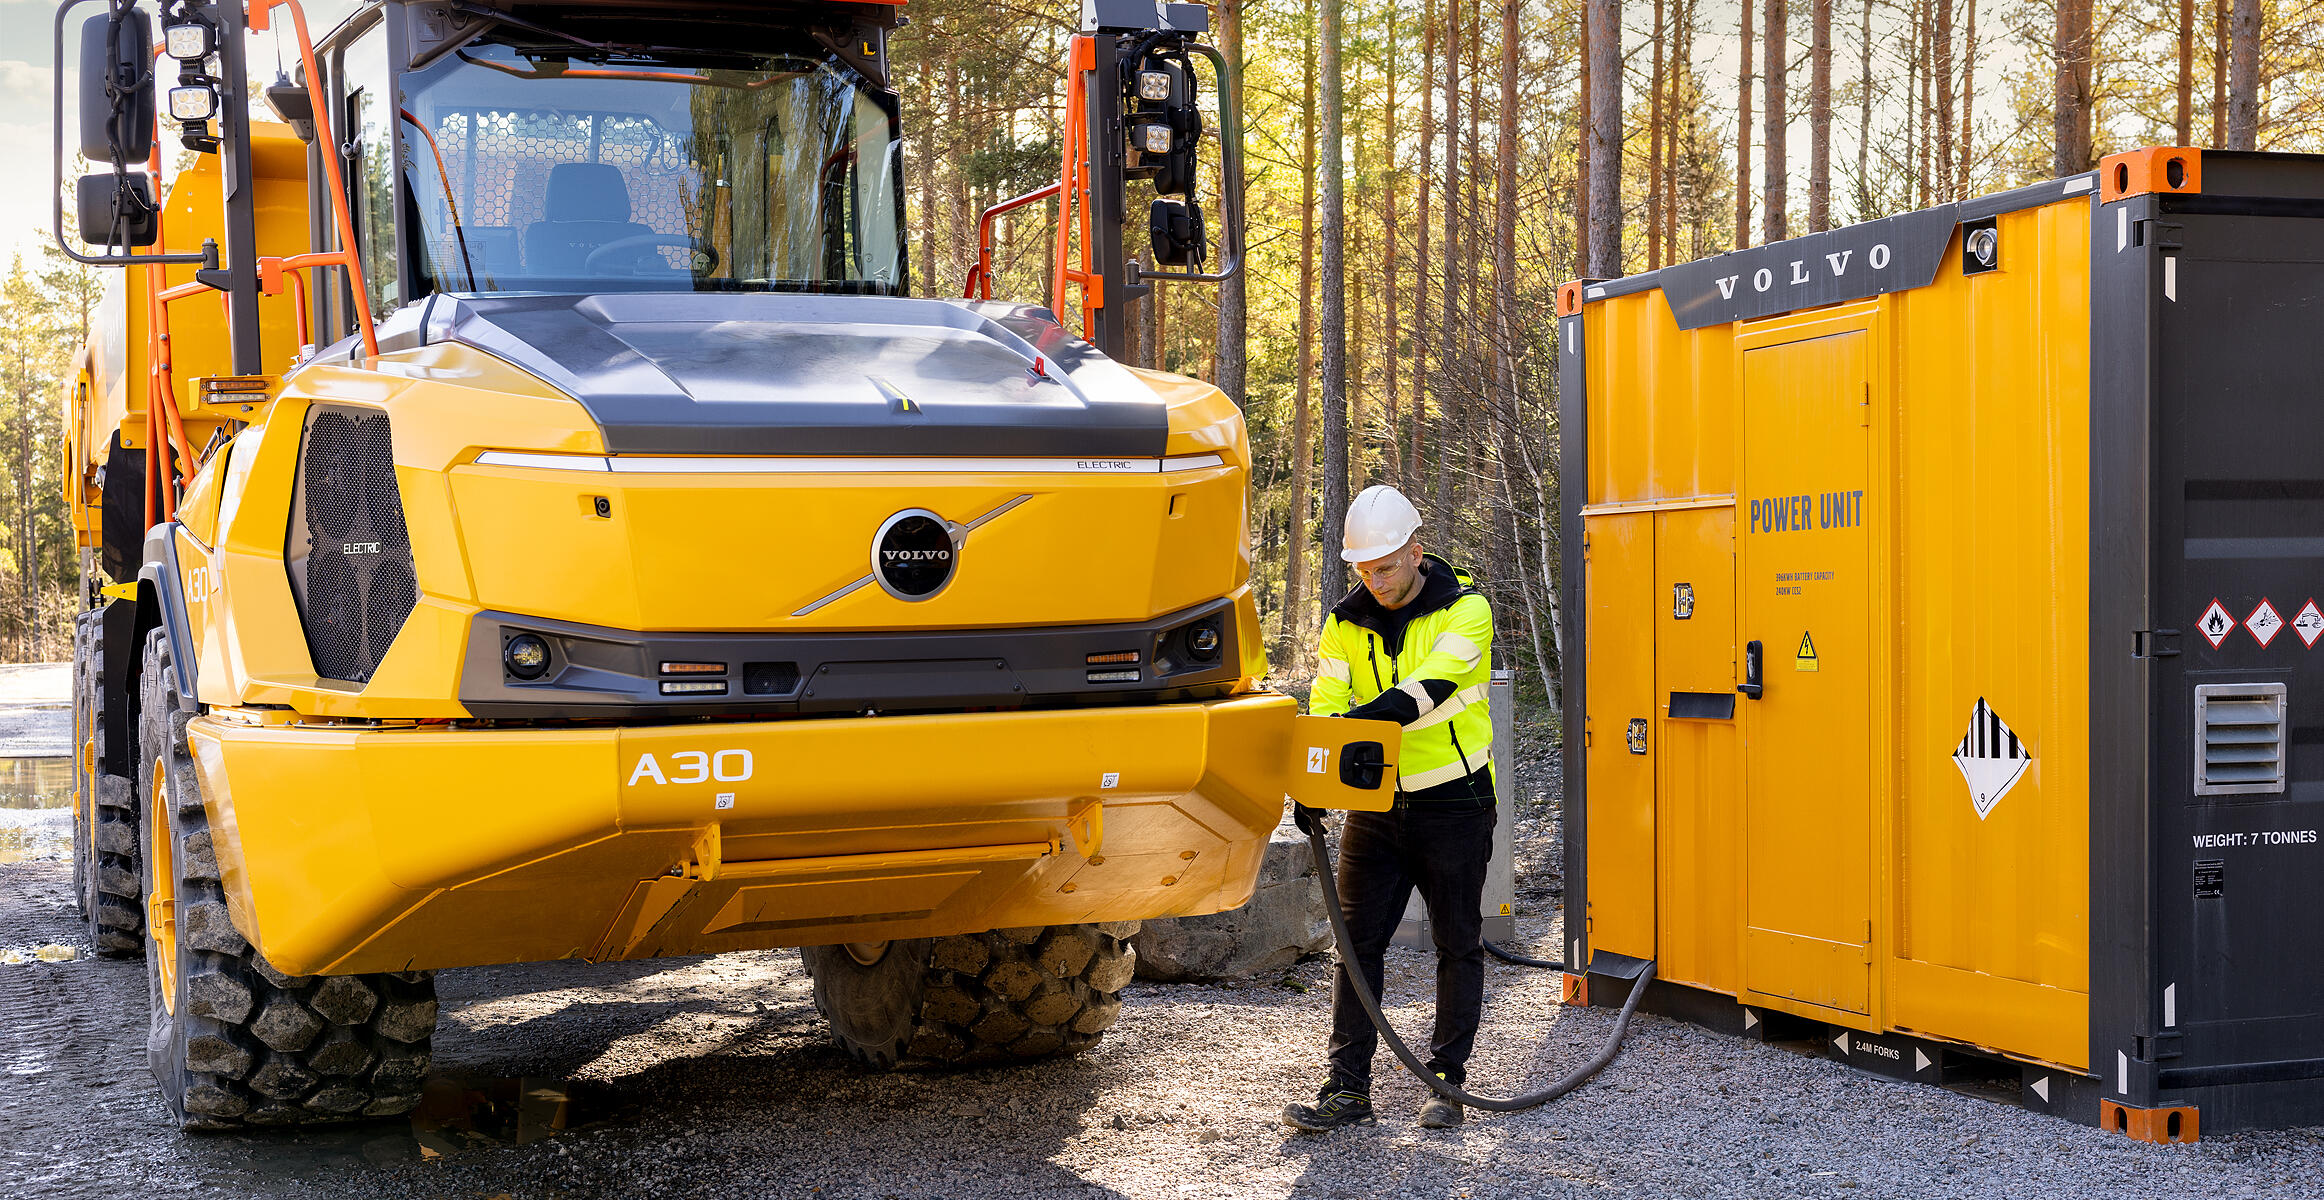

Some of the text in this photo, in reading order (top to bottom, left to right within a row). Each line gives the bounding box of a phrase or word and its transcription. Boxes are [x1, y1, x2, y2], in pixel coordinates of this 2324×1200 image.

[1715, 243, 1891, 300] VOLVO
[1077, 461, 1131, 469] ELECTRIC
[1750, 490, 1863, 534] POWER UNIT
[343, 541, 380, 554] ELECTRIC
[882, 550, 950, 560] VOLVO
[187, 566, 208, 604] A30
[1794, 572, 1813, 582] BATTERY
[1813, 571, 1834, 581] CAPACITY
[627, 749, 754, 787] A30
[1980, 792, 1986, 803] 9
[2192, 829, 2318, 849] WEIGHT: 7 TONNES
[1855, 1040, 1900, 1060] 2.4M FORKS
